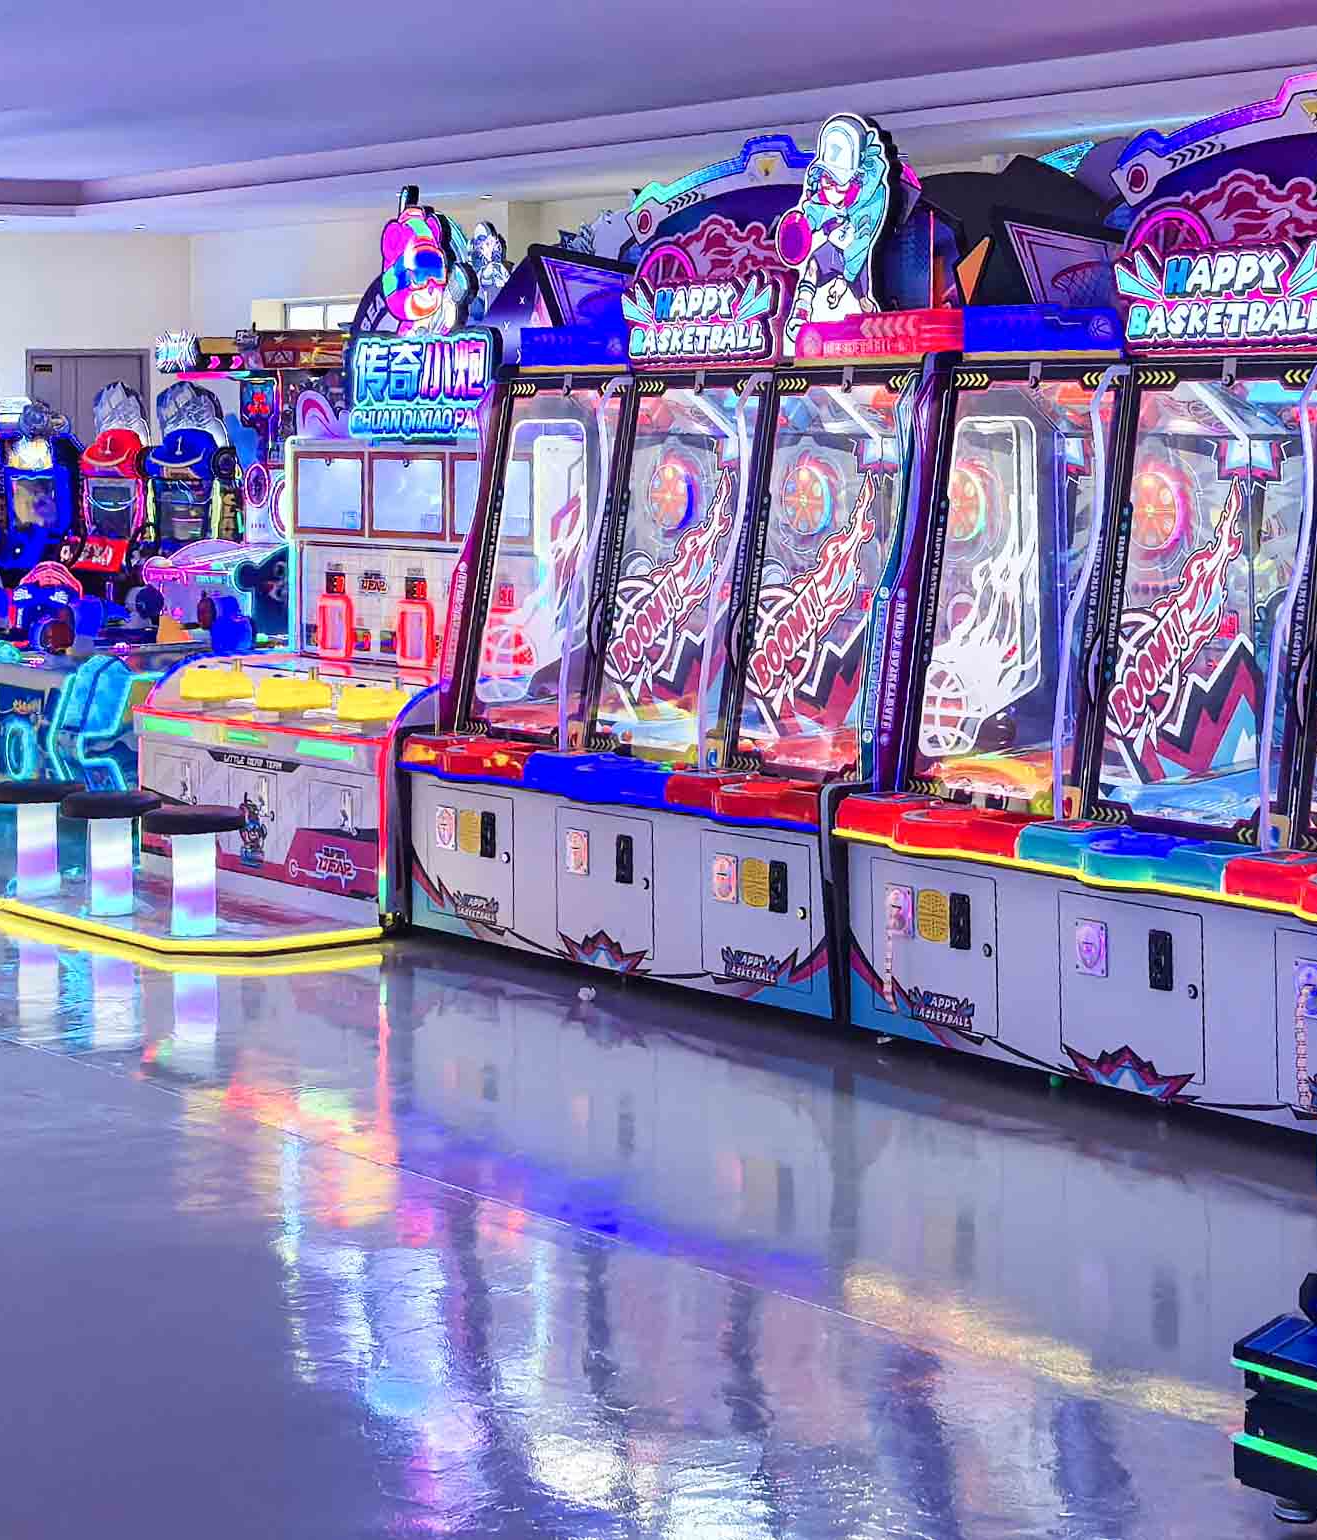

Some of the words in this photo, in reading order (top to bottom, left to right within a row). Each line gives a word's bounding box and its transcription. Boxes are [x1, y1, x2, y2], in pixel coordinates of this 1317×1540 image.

[1164, 253, 1286, 298] HAPPY
[360, 293, 385, 331] BEA
[654, 283, 735, 323] HAPPY
[629, 322, 765, 357] BASKETBALL
[357, 341, 487, 402] 传奇小炮
[609, 570, 682, 679] BOOM!!
[749, 577, 825, 696] BOOM!!
[1109, 600, 1189, 735] BOOM!!
